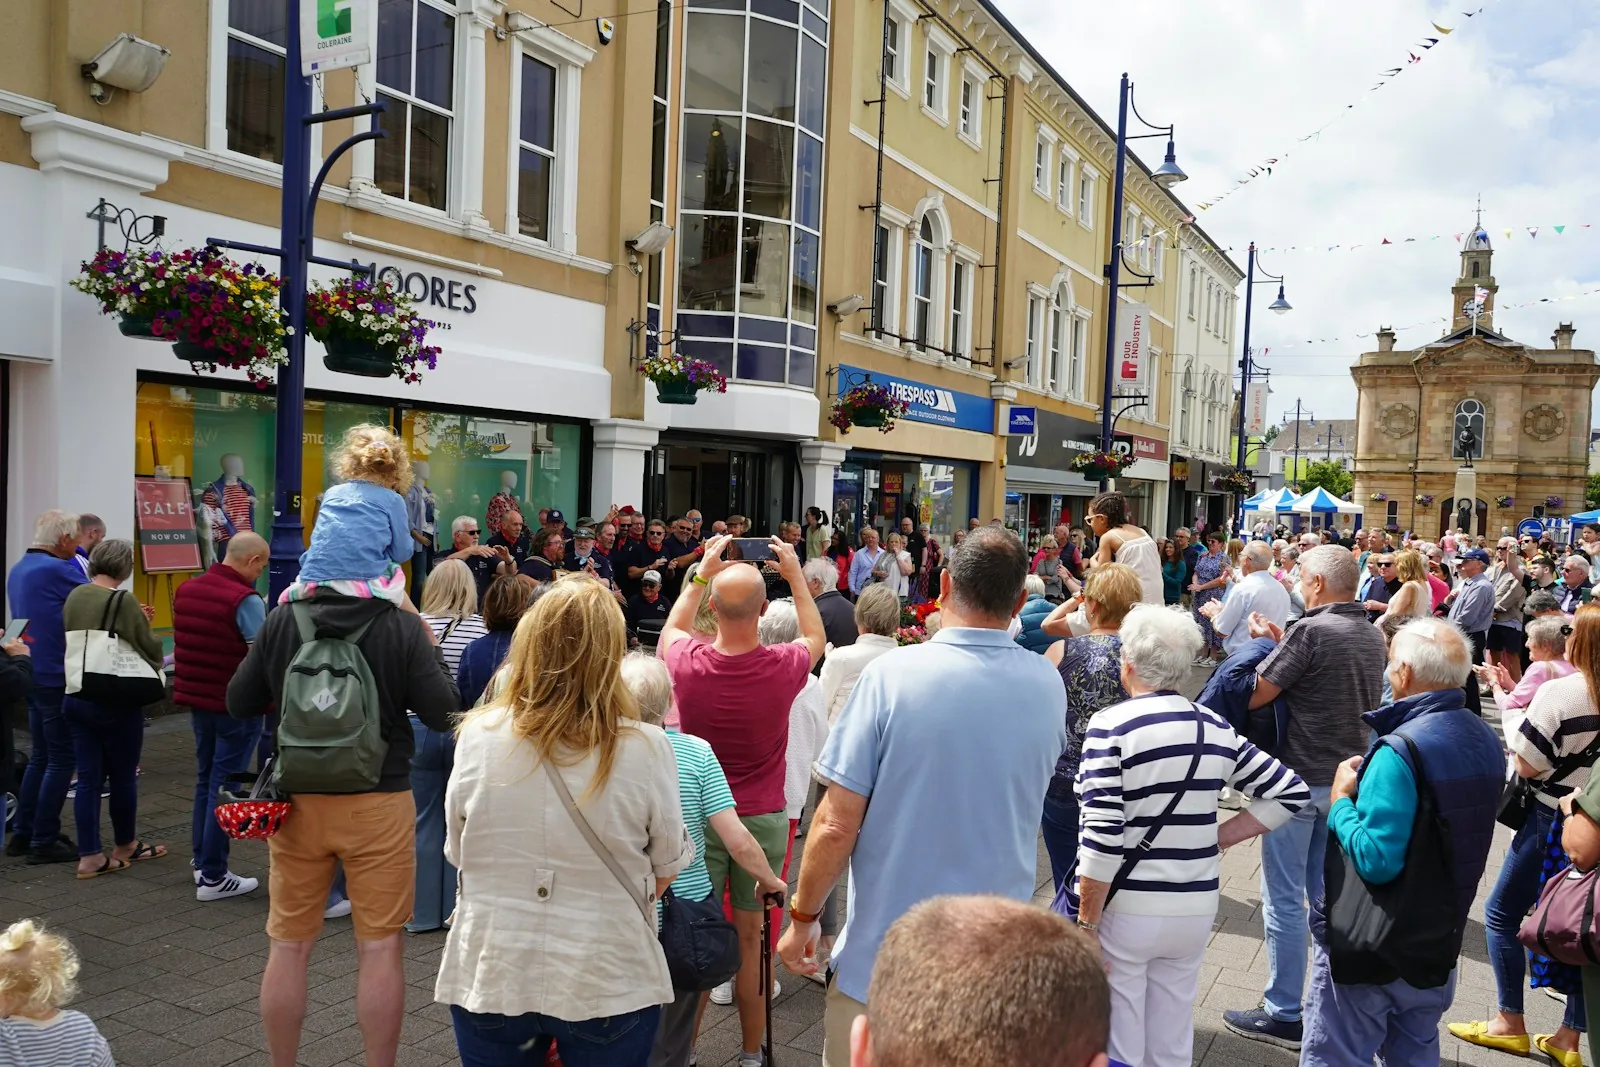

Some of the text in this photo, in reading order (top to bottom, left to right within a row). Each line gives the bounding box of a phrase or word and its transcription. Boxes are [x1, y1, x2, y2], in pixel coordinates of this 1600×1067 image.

[317, 36, 352, 49] COLERAINE
[1131, 314, 1141, 359] INDUSTRY
[889, 381, 935, 407] TRESPASS
[293, 495, 301, 508] 5
[144, 502, 186, 515] SALE
